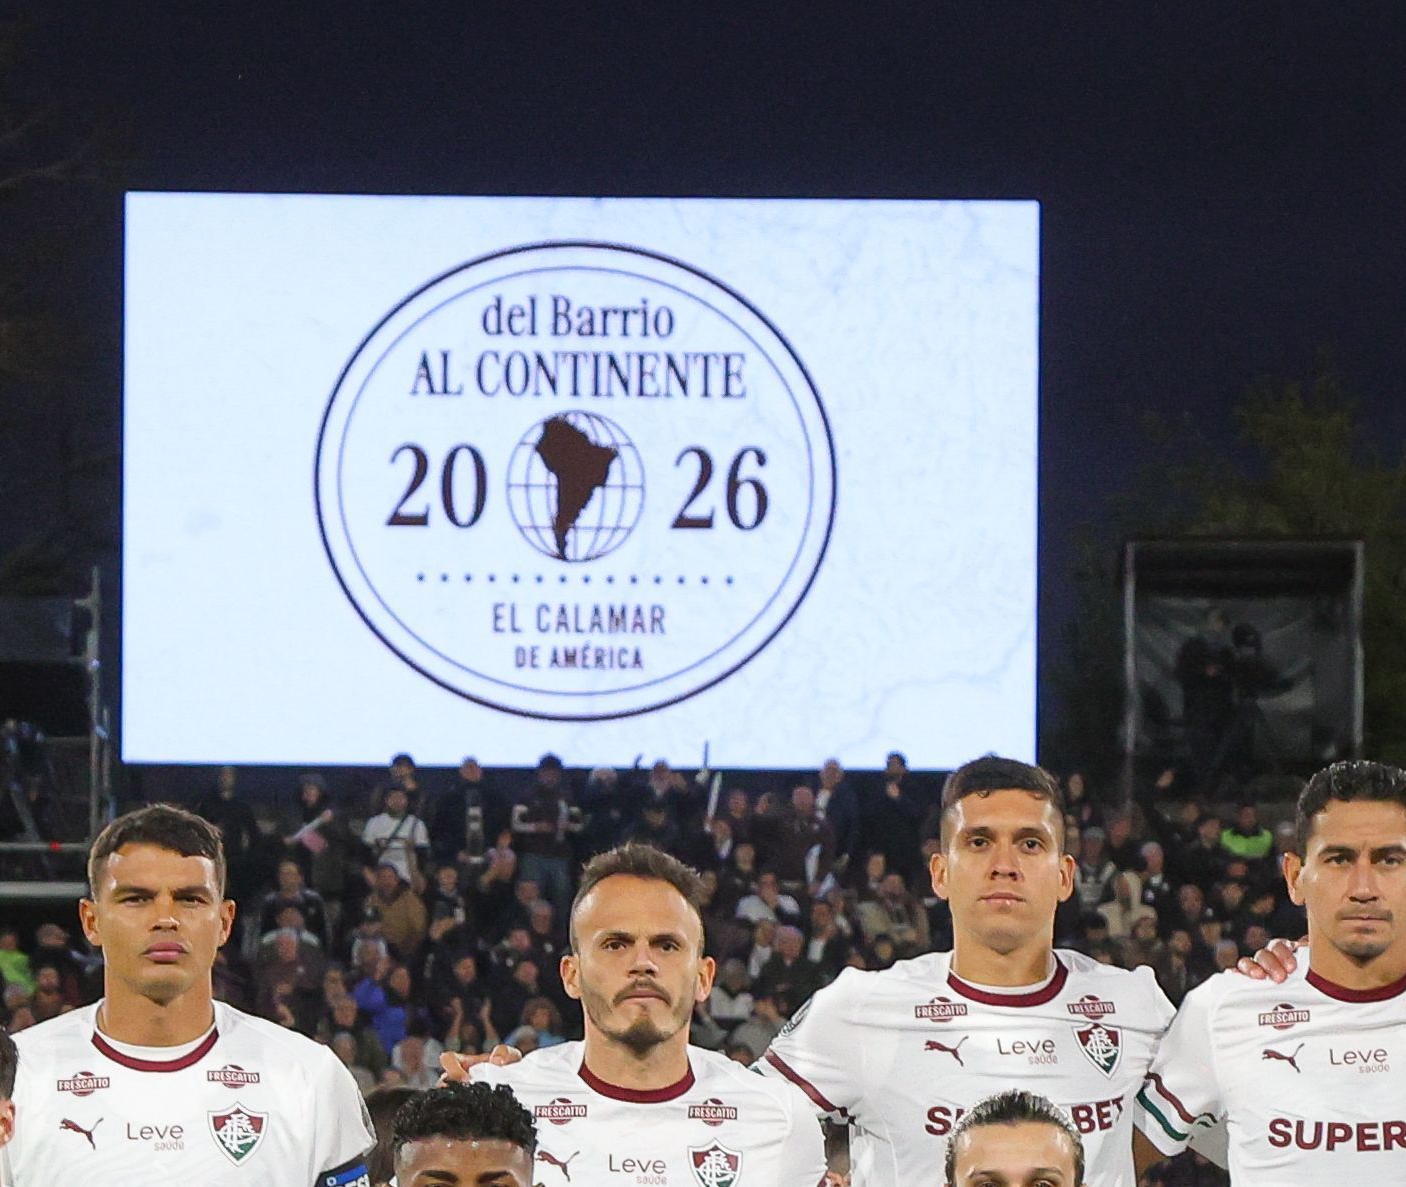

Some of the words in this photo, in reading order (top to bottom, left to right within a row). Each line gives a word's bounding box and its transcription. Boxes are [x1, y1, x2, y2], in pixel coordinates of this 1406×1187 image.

[482, 295, 537, 336] del
[551, 295, 674, 338] Barrio
[410, 350, 464, 395] AL
[477, 350, 747, 398] CONTINENTE
[386, 442, 488, 528] 20
[670, 446, 768, 530] 26
[492, 602, 522, 633] EL
[536, 603, 666, 635] CALAMAR
[515, 646, 540, 669] DE
[550, 640, 642, 669] AMÉRICA
[915, 1004, 967, 1018] FRESCATTO
[1259, 1011, 1309, 1025] FRESCATTO
[997, 1037, 1055, 1057] Leve
[1329, 1047, 1388, 1065] Leve
[57, 1077, 110, 1091] FRESCATTO
[208, 1071, 259, 1084] FRESCATTO
[536, 1105, 586, 1118] FRESCATTO
[689, 1106, 736, 1119] FRESCATTO
[925, 1096, 1124, 1136] SBET
[127, 1122, 184, 1141] Leve
[609, 1153, 666, 1175] Leve
